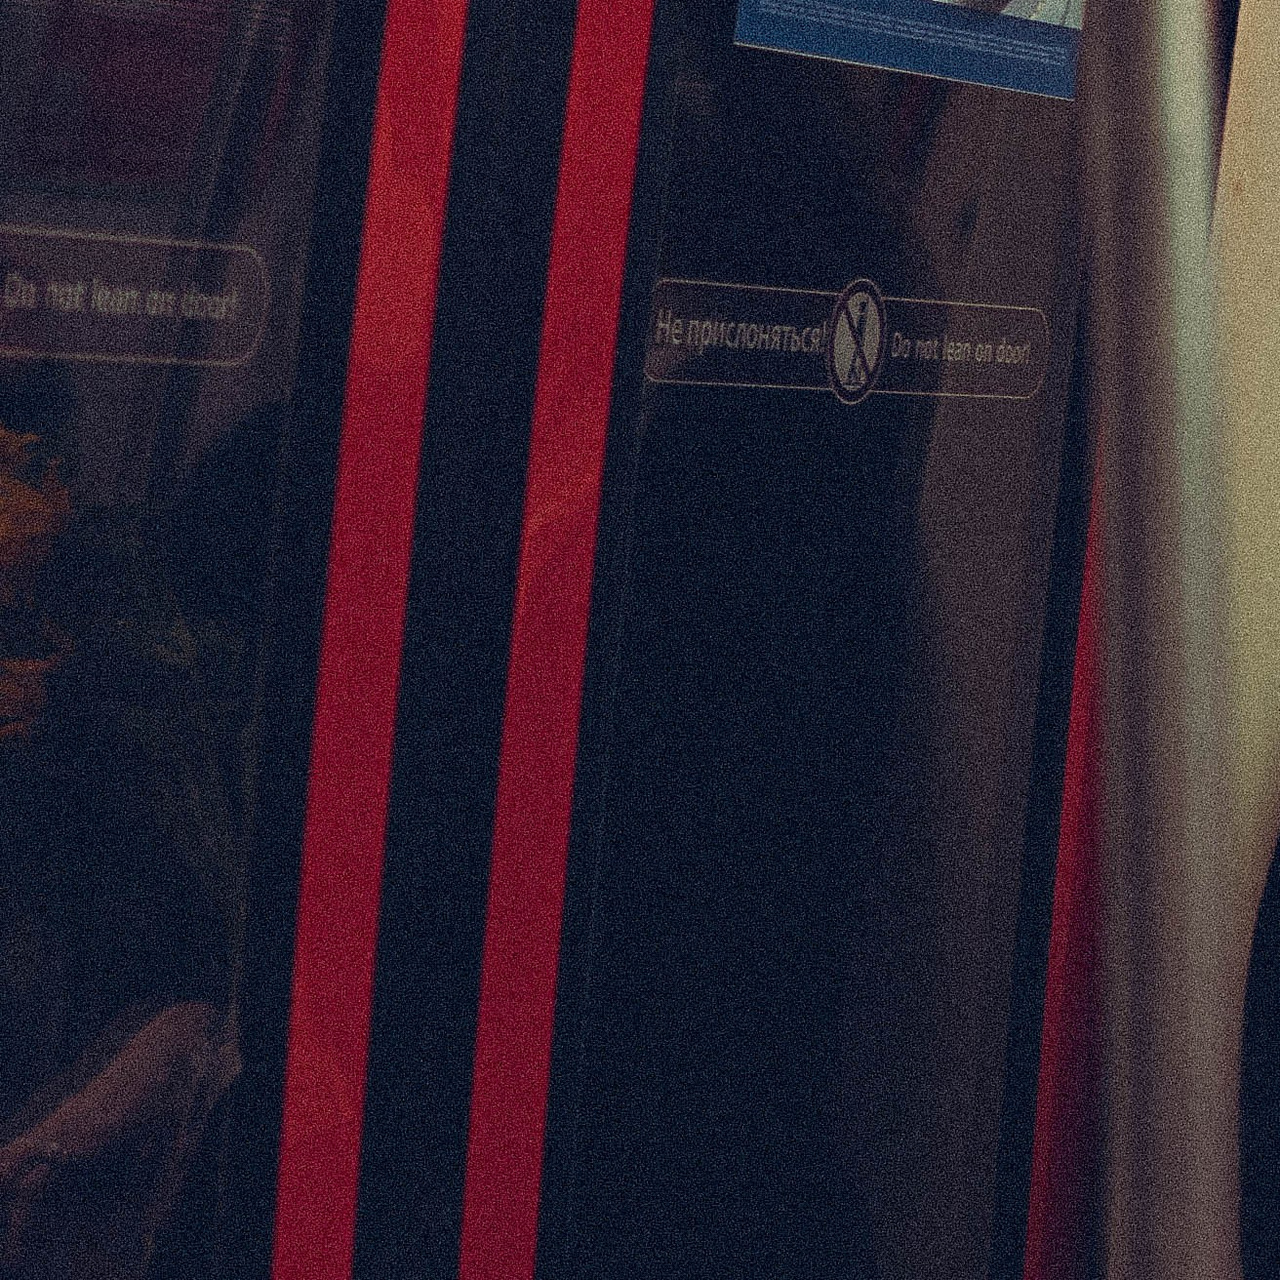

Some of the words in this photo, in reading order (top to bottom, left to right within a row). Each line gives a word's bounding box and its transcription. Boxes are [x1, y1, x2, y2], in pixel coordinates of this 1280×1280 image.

[654, 308, 684, 346] Не
[686, 318, 829, 356] прислоняться!
[890, 331, 912, 359] Do
[914, 337, 939, 360] not
[942, 333, 972, 362] lean
[974, 342, 993, 363] on
